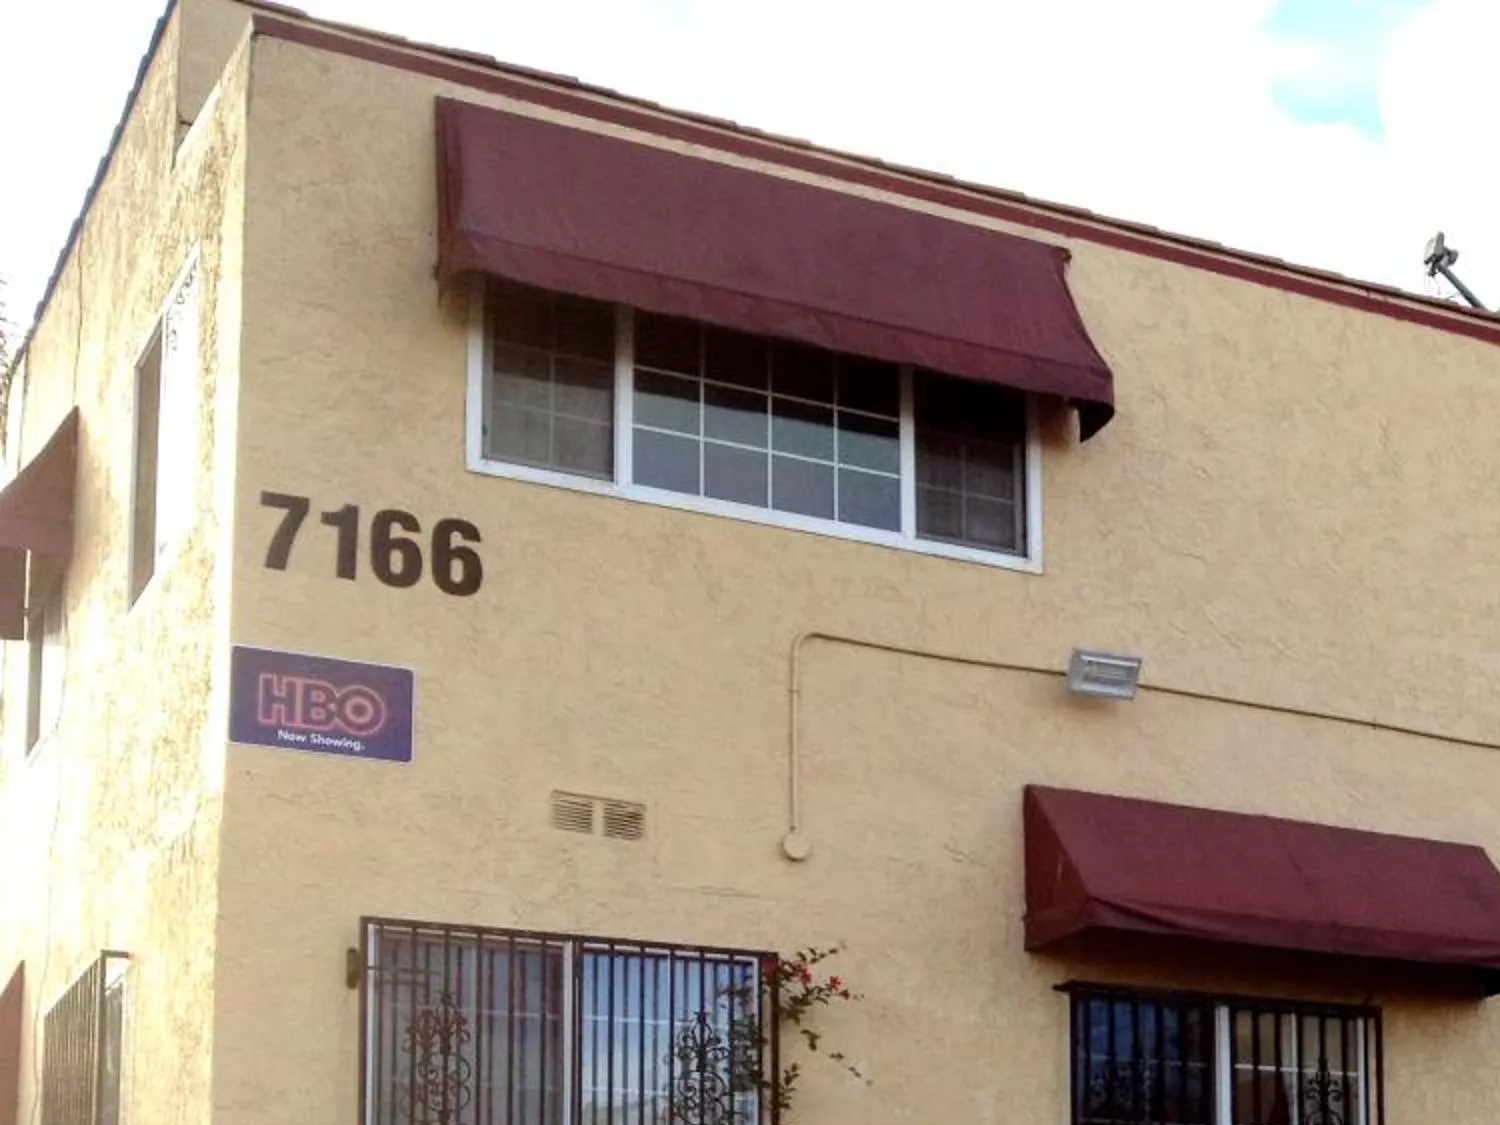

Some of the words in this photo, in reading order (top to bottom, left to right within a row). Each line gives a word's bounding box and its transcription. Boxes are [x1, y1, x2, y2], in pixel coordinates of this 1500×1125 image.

[260, 490, 484, 597] 7166
[258, 673, 387, 735] HBO
[277, 729, 307, 743] Now
